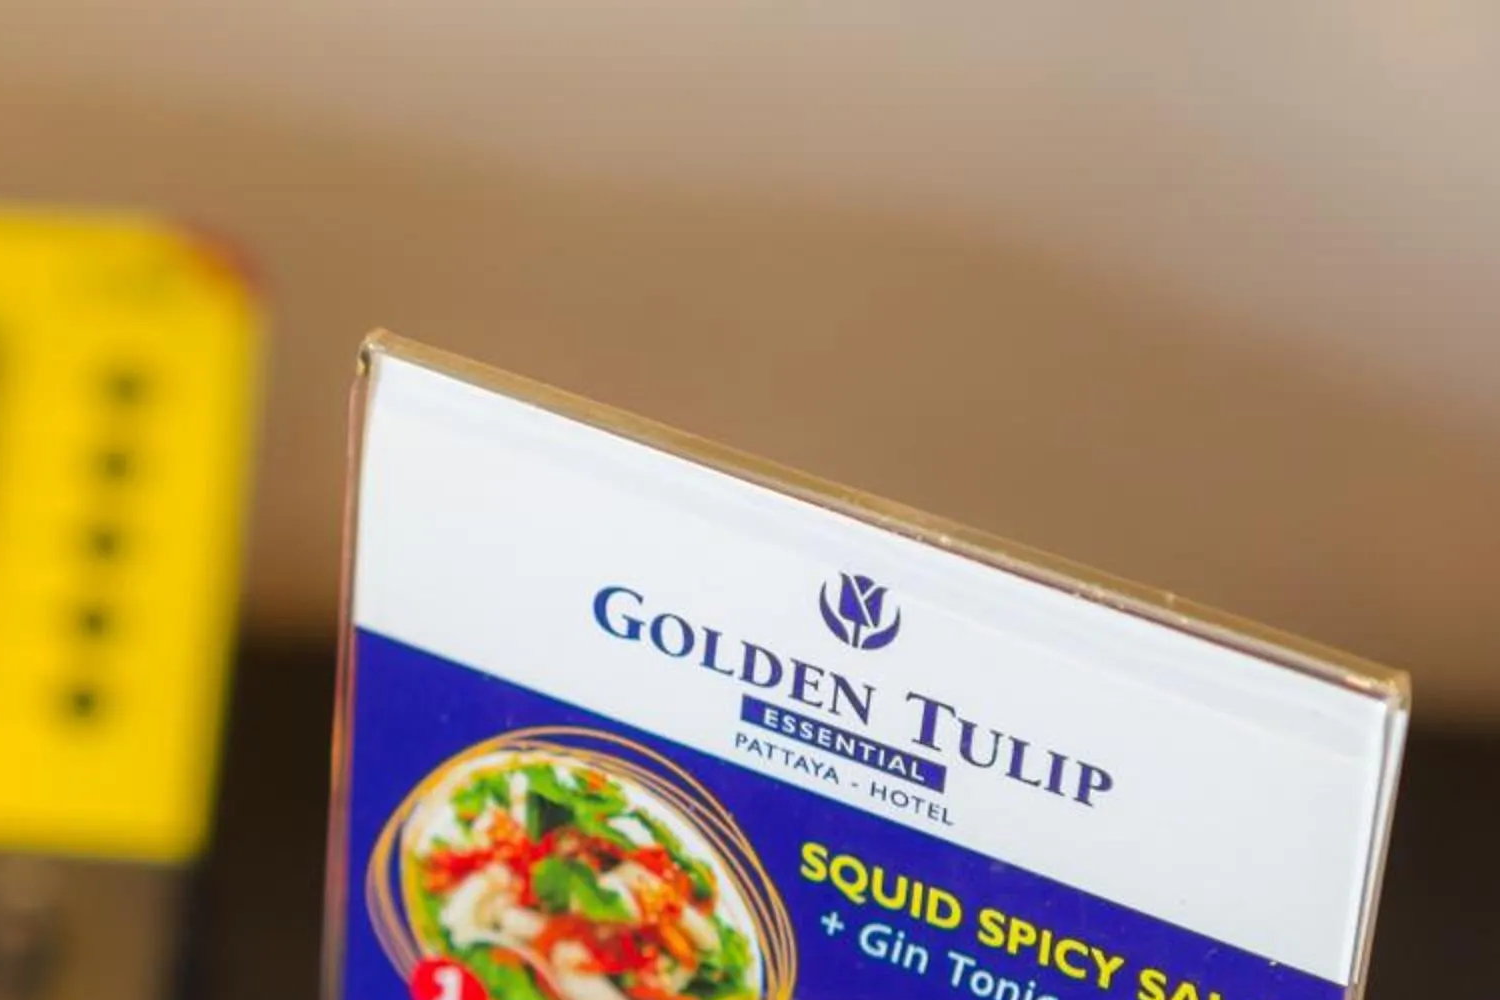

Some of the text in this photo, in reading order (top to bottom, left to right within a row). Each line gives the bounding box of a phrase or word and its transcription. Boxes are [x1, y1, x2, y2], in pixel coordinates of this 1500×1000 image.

[734, 732, 841, 786] PATTAYA
[869, 781, 956, 826] HOTEL
[761, 708, 926, 783] ESSENTIAL
[906, 692, 1113, 808] TULIP
[801, 842, 962, 931] SQUID
[977, 908, 1124, 989] SPICY
[858, 922, 929, 974] Gin
